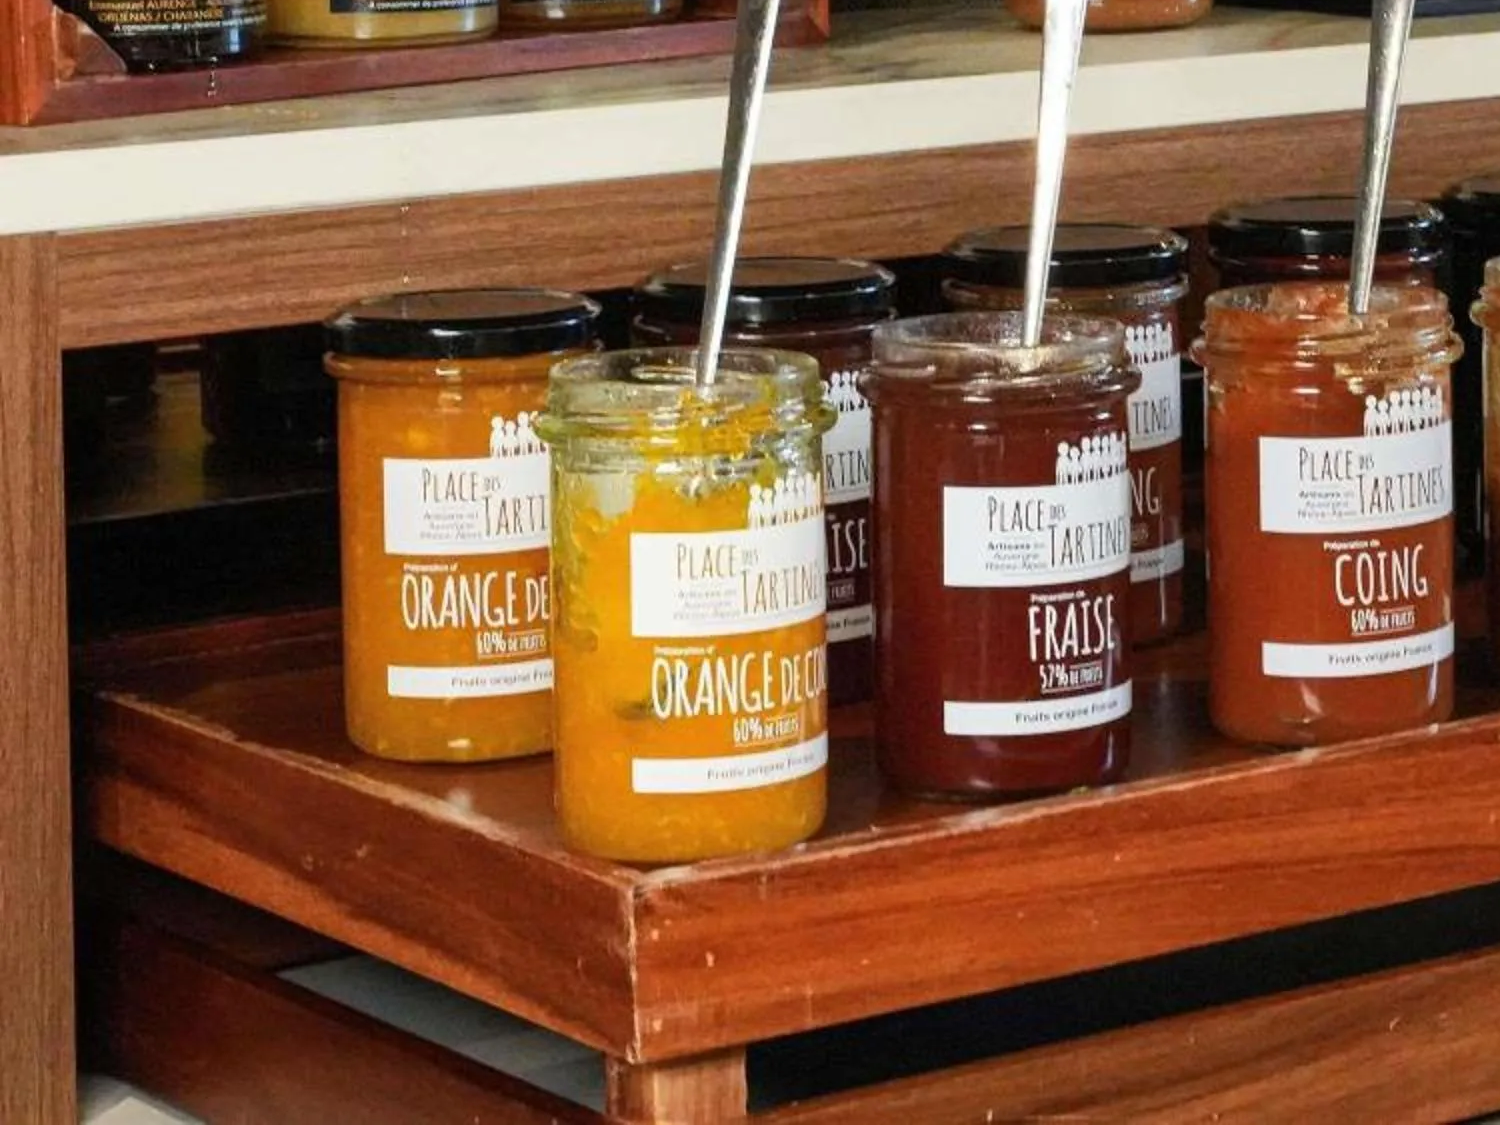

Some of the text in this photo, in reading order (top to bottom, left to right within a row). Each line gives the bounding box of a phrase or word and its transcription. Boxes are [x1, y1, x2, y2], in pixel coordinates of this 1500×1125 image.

[422, 468, 478, 504] PLACE
[1298, 447, 1353, 481] PLACE
[1358, 465, 1446, 515] TARTINES
[481, 493, 548, 537] TARTI
[987, 494, 1045, 532] PLACE
[676, 542, 737, 581] PLACE
[1047, 515, 1127, 568] TARTINE
[1334, 543, 1429, 607] COING
[402, 572, 549, 630] ORANGE DE
[1028, 594, 1116, 663] FRAISE
[651, 650, 775, 720] ORANGE
[780, 650, 802, 702] DE
[1039, 663, 1069, 689] 57%
[733, 717, 763, 743] 60%
